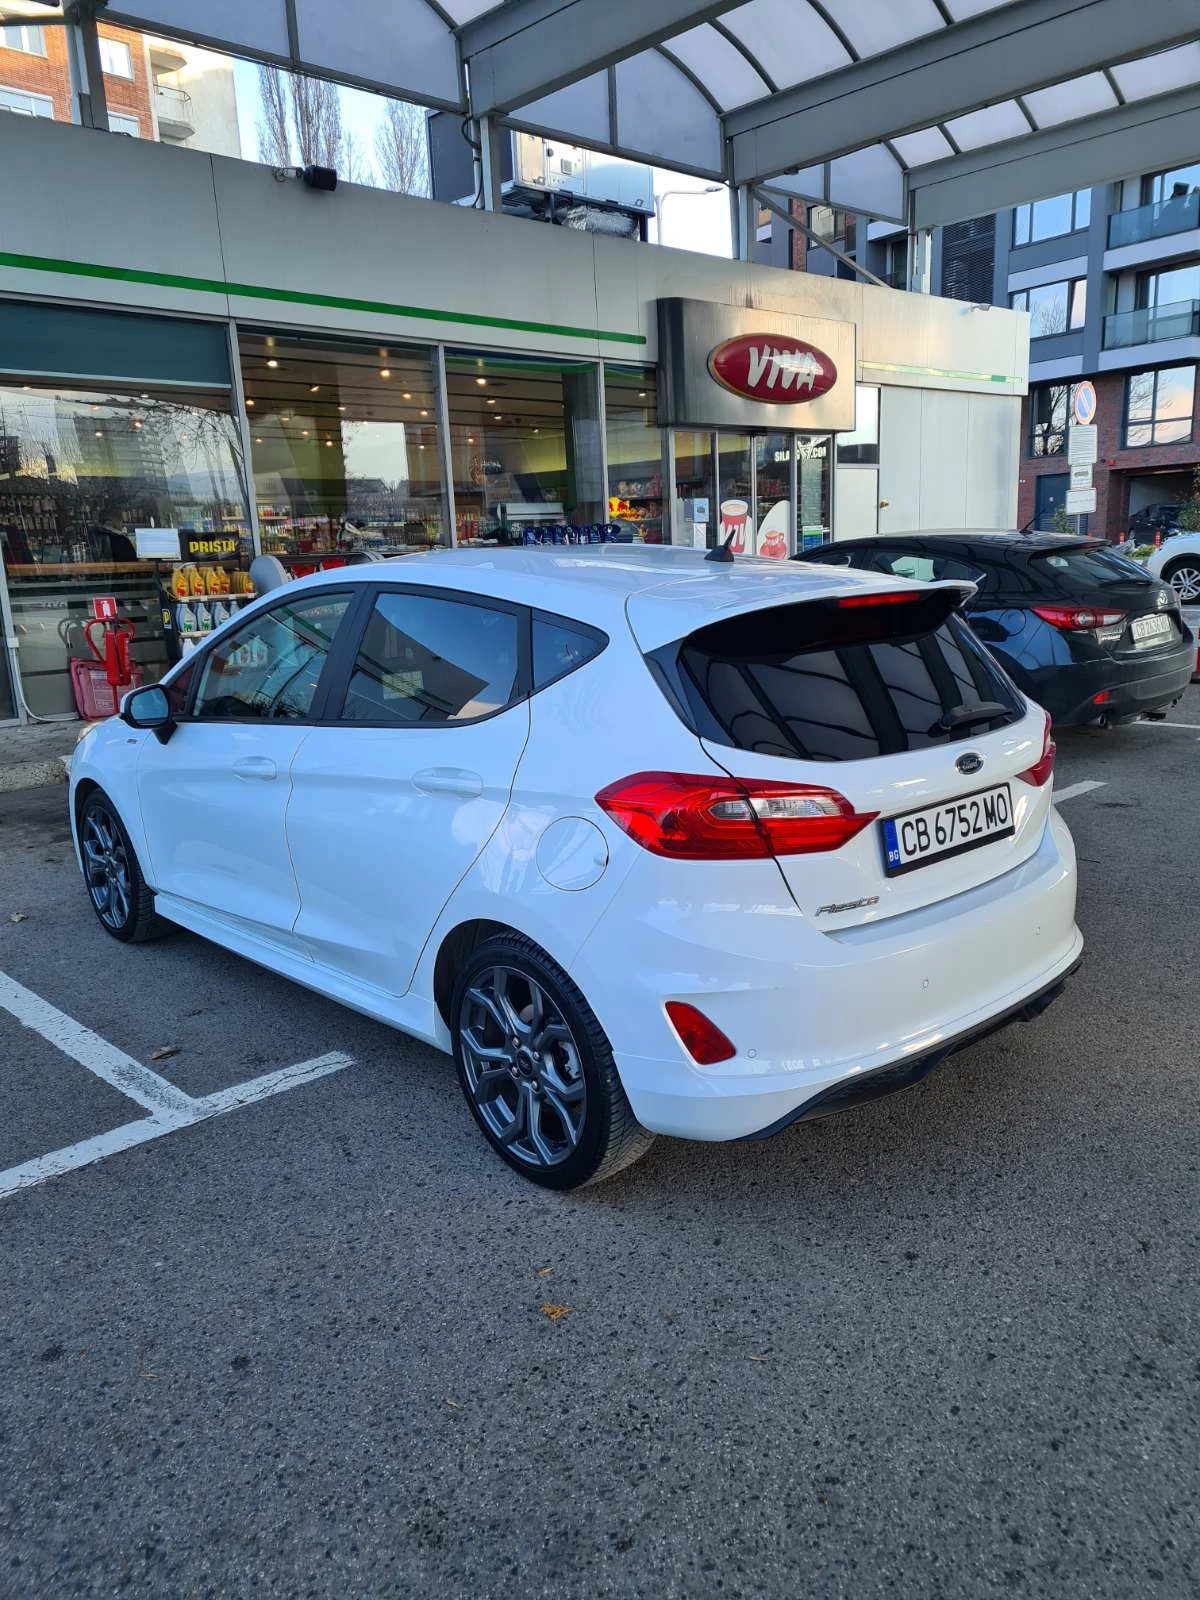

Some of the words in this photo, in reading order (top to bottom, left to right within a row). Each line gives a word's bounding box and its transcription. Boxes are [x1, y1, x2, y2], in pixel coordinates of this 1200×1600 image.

[747, 344, 824, 391] VIVA
[188, 539, 237, 553] PRISTA
[901, 817, 931, 856] CB
[935, 801, 983, 845] 6752
[983, 793, 1008, 830] MO
[888, 849, 900, 862] BG
[815, 895, 880, 917] Fiesta
